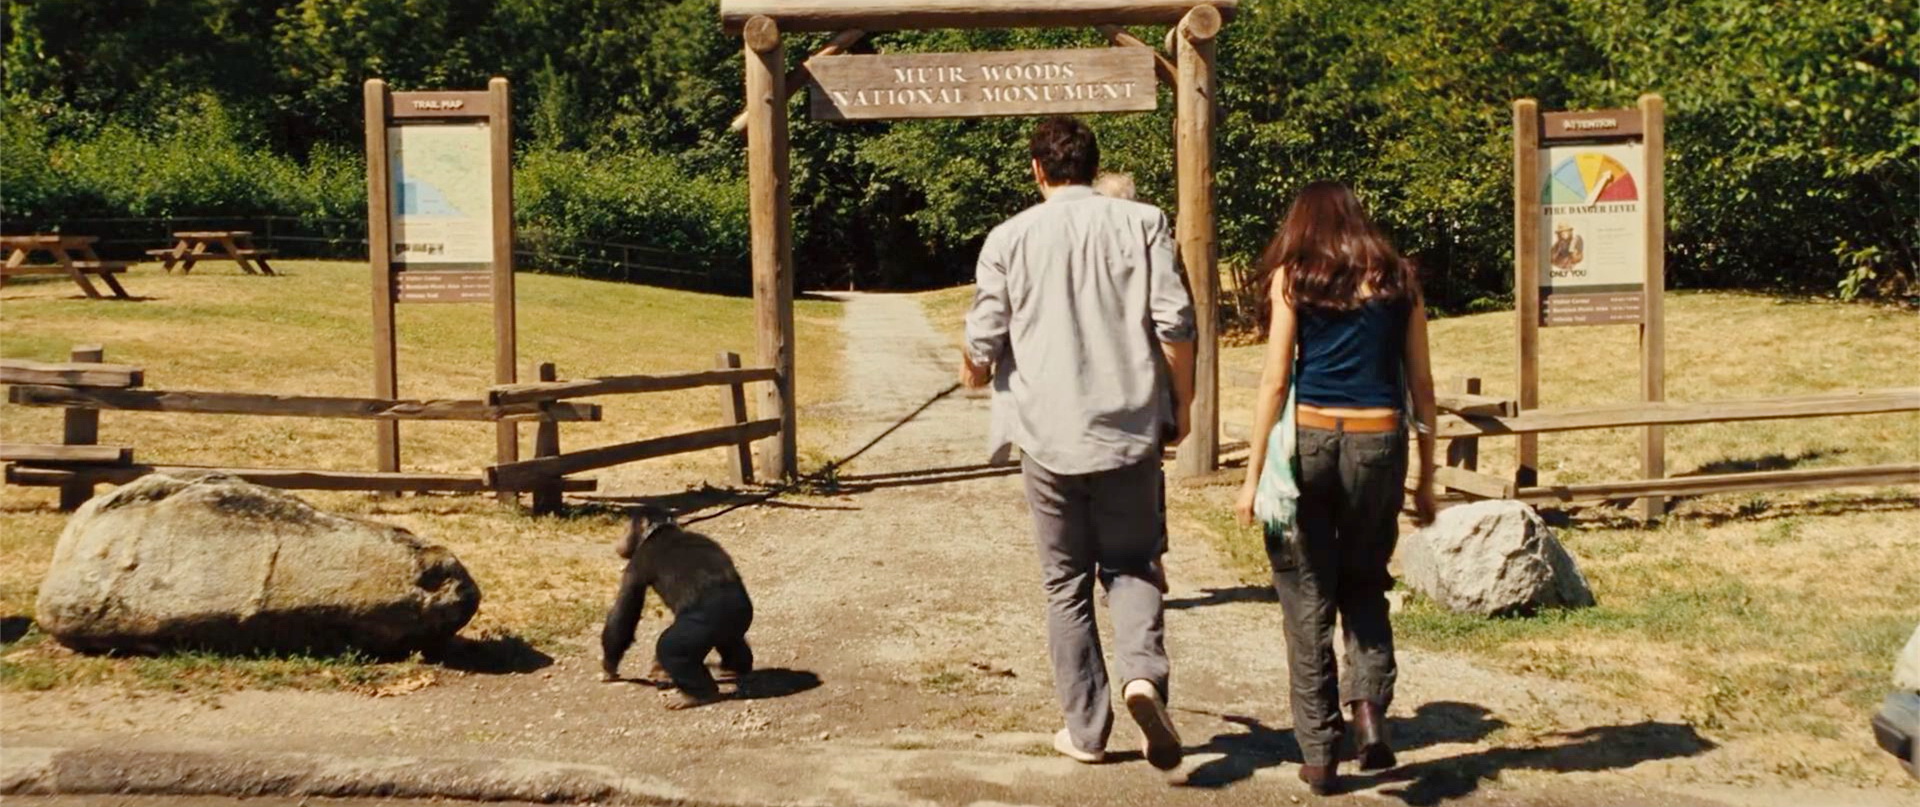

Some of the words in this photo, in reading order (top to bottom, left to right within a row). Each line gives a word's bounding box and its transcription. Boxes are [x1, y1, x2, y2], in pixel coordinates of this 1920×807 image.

[894, 66, 967, 84] MUIR
[981, 62, 1075, 81] WOODS
[830, 86, 965, 107] NATIONAL
[981, 81, 1137, 103] MONUMENT
[412, 99, 441, 110] TRAIL
[441, 99, 464, 110] MAP
[1563, 118, 1618, 131] ATTENTION
[1544, 206, 1567, 216] FIRE
[1568, 205, 1607, 215] DANGER
[1609, 204, 1637, 213] LEVEL
[1549, 270, 1569, 278] ONLY
[1571, 269, 1587, 277] YOU
